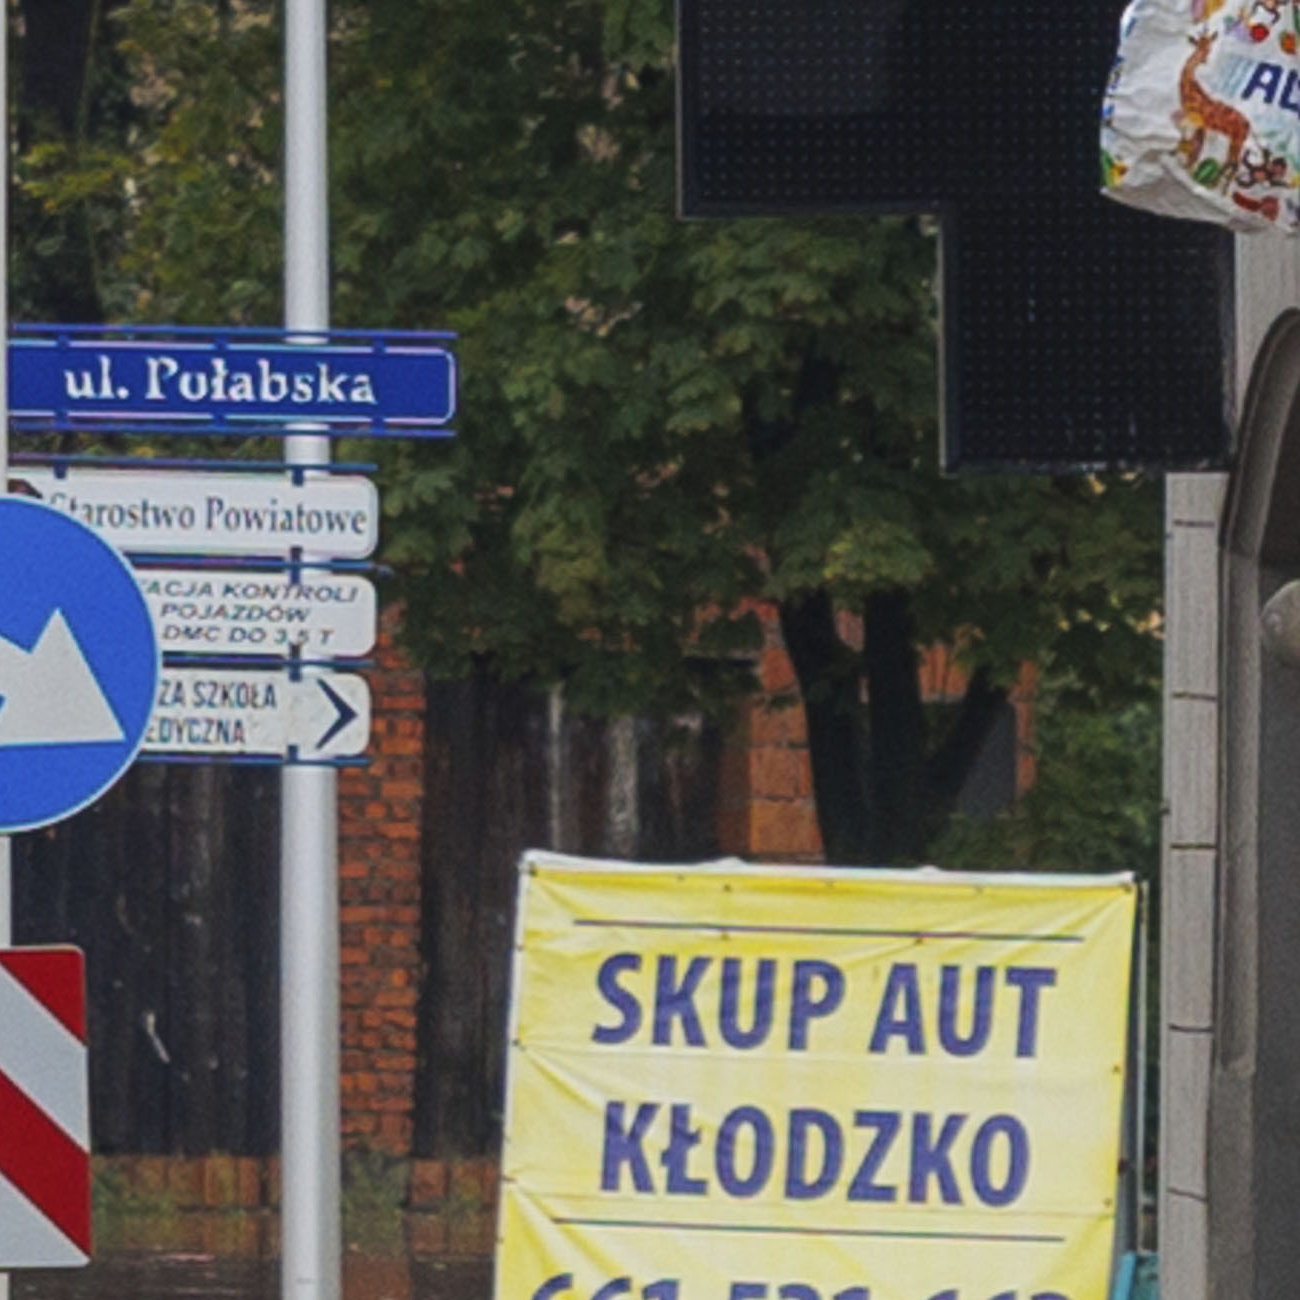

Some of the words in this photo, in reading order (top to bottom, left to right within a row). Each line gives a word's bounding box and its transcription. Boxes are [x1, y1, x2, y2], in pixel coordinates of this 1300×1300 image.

[64, 354, 130, 399] ul.
[145, 355, 378, 405] Połabska
[205, 495, 368, 535] Powiatowe
[221, 582, 359, 603] KONTROLI
[160, 601, 312, 623] POJAZDÓW
[162, 624, 222, 642] DMC
[228, 626, 267, 644] DO
[193, 680, 278, 709] SZKOŁA
[590, 951, 847, 1052] SKUP
[867, 962, 1059, 1058] AUT
[600, 1100, 1031, 1208] KŁODZKO
